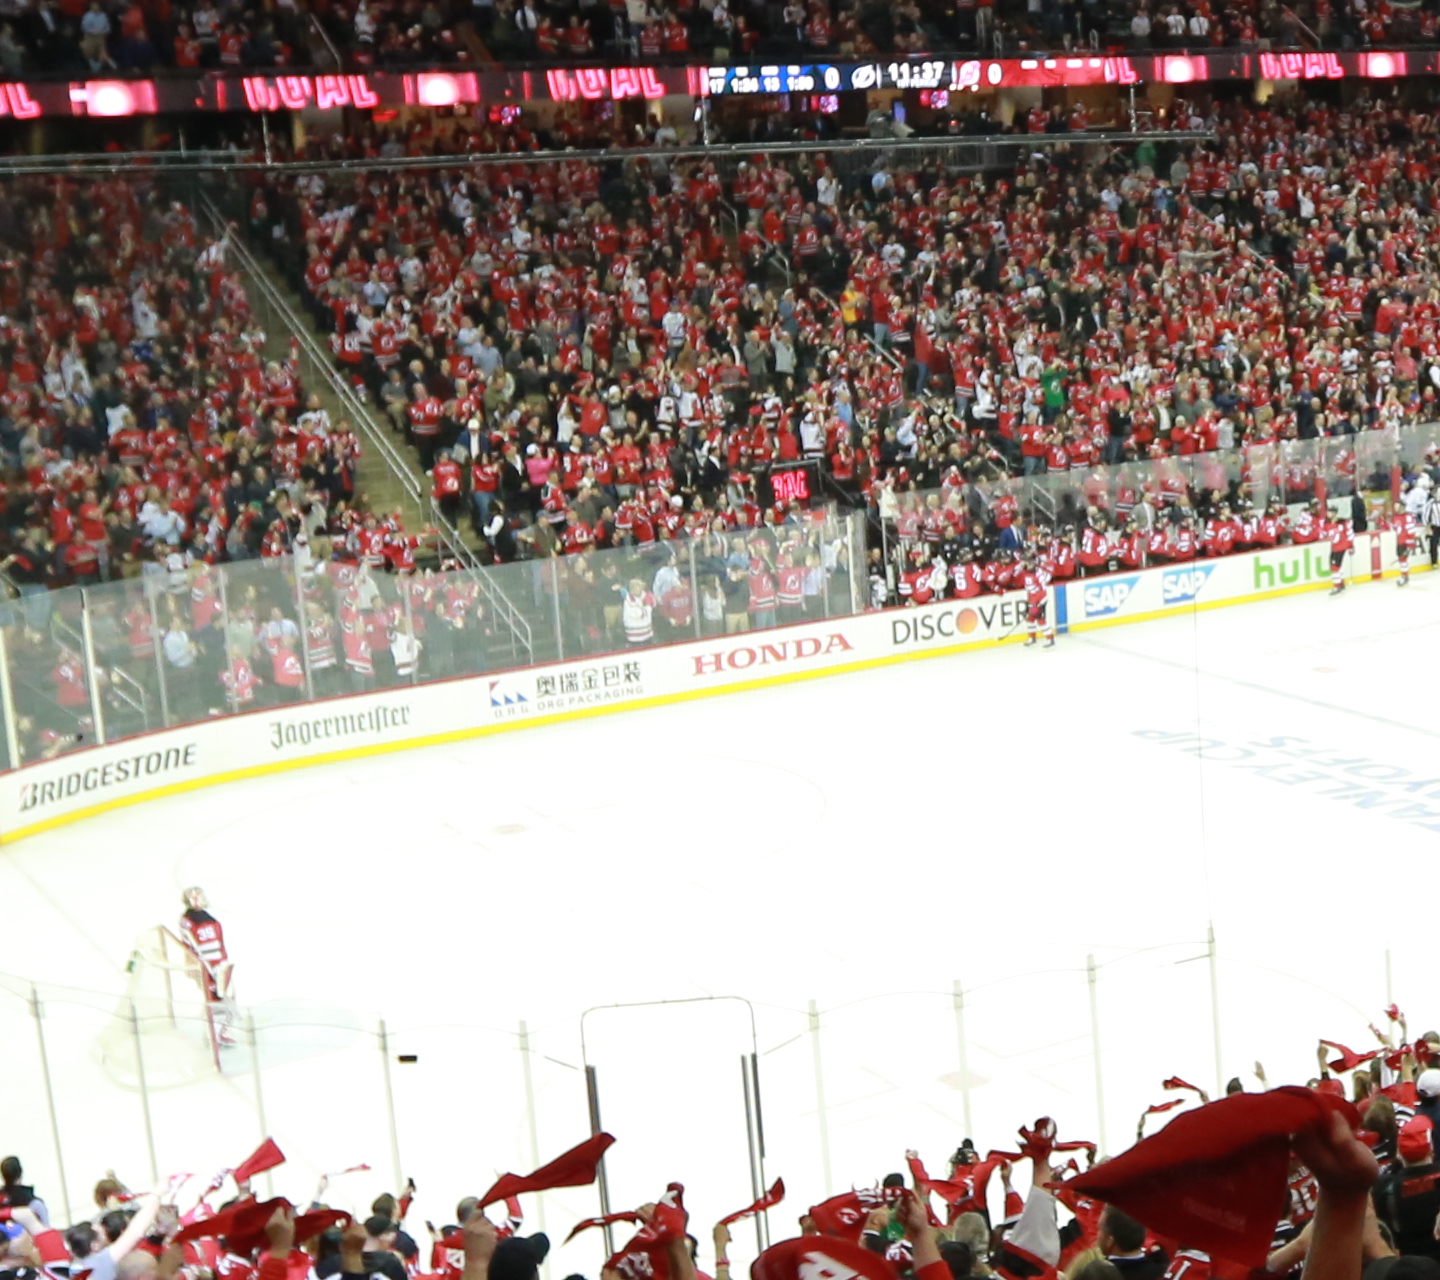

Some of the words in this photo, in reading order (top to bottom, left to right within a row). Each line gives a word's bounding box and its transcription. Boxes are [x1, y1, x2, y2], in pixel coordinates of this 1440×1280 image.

[888, 58, 946, 83] 11:37
[1162, 571, 1208, 604] SAP
[1253, 547, 1335, 591] hulu
[1084, 581, 1132, 616] SAP
[891, 599, 1032, 647] DISCOVER
[691, 631, 855, 677] HONDA
[537, 697, 565, 713] ORG
[568, 683, 645, 709] PACKAGING
[17, 742, 198, 814] BRIDGESTONE
